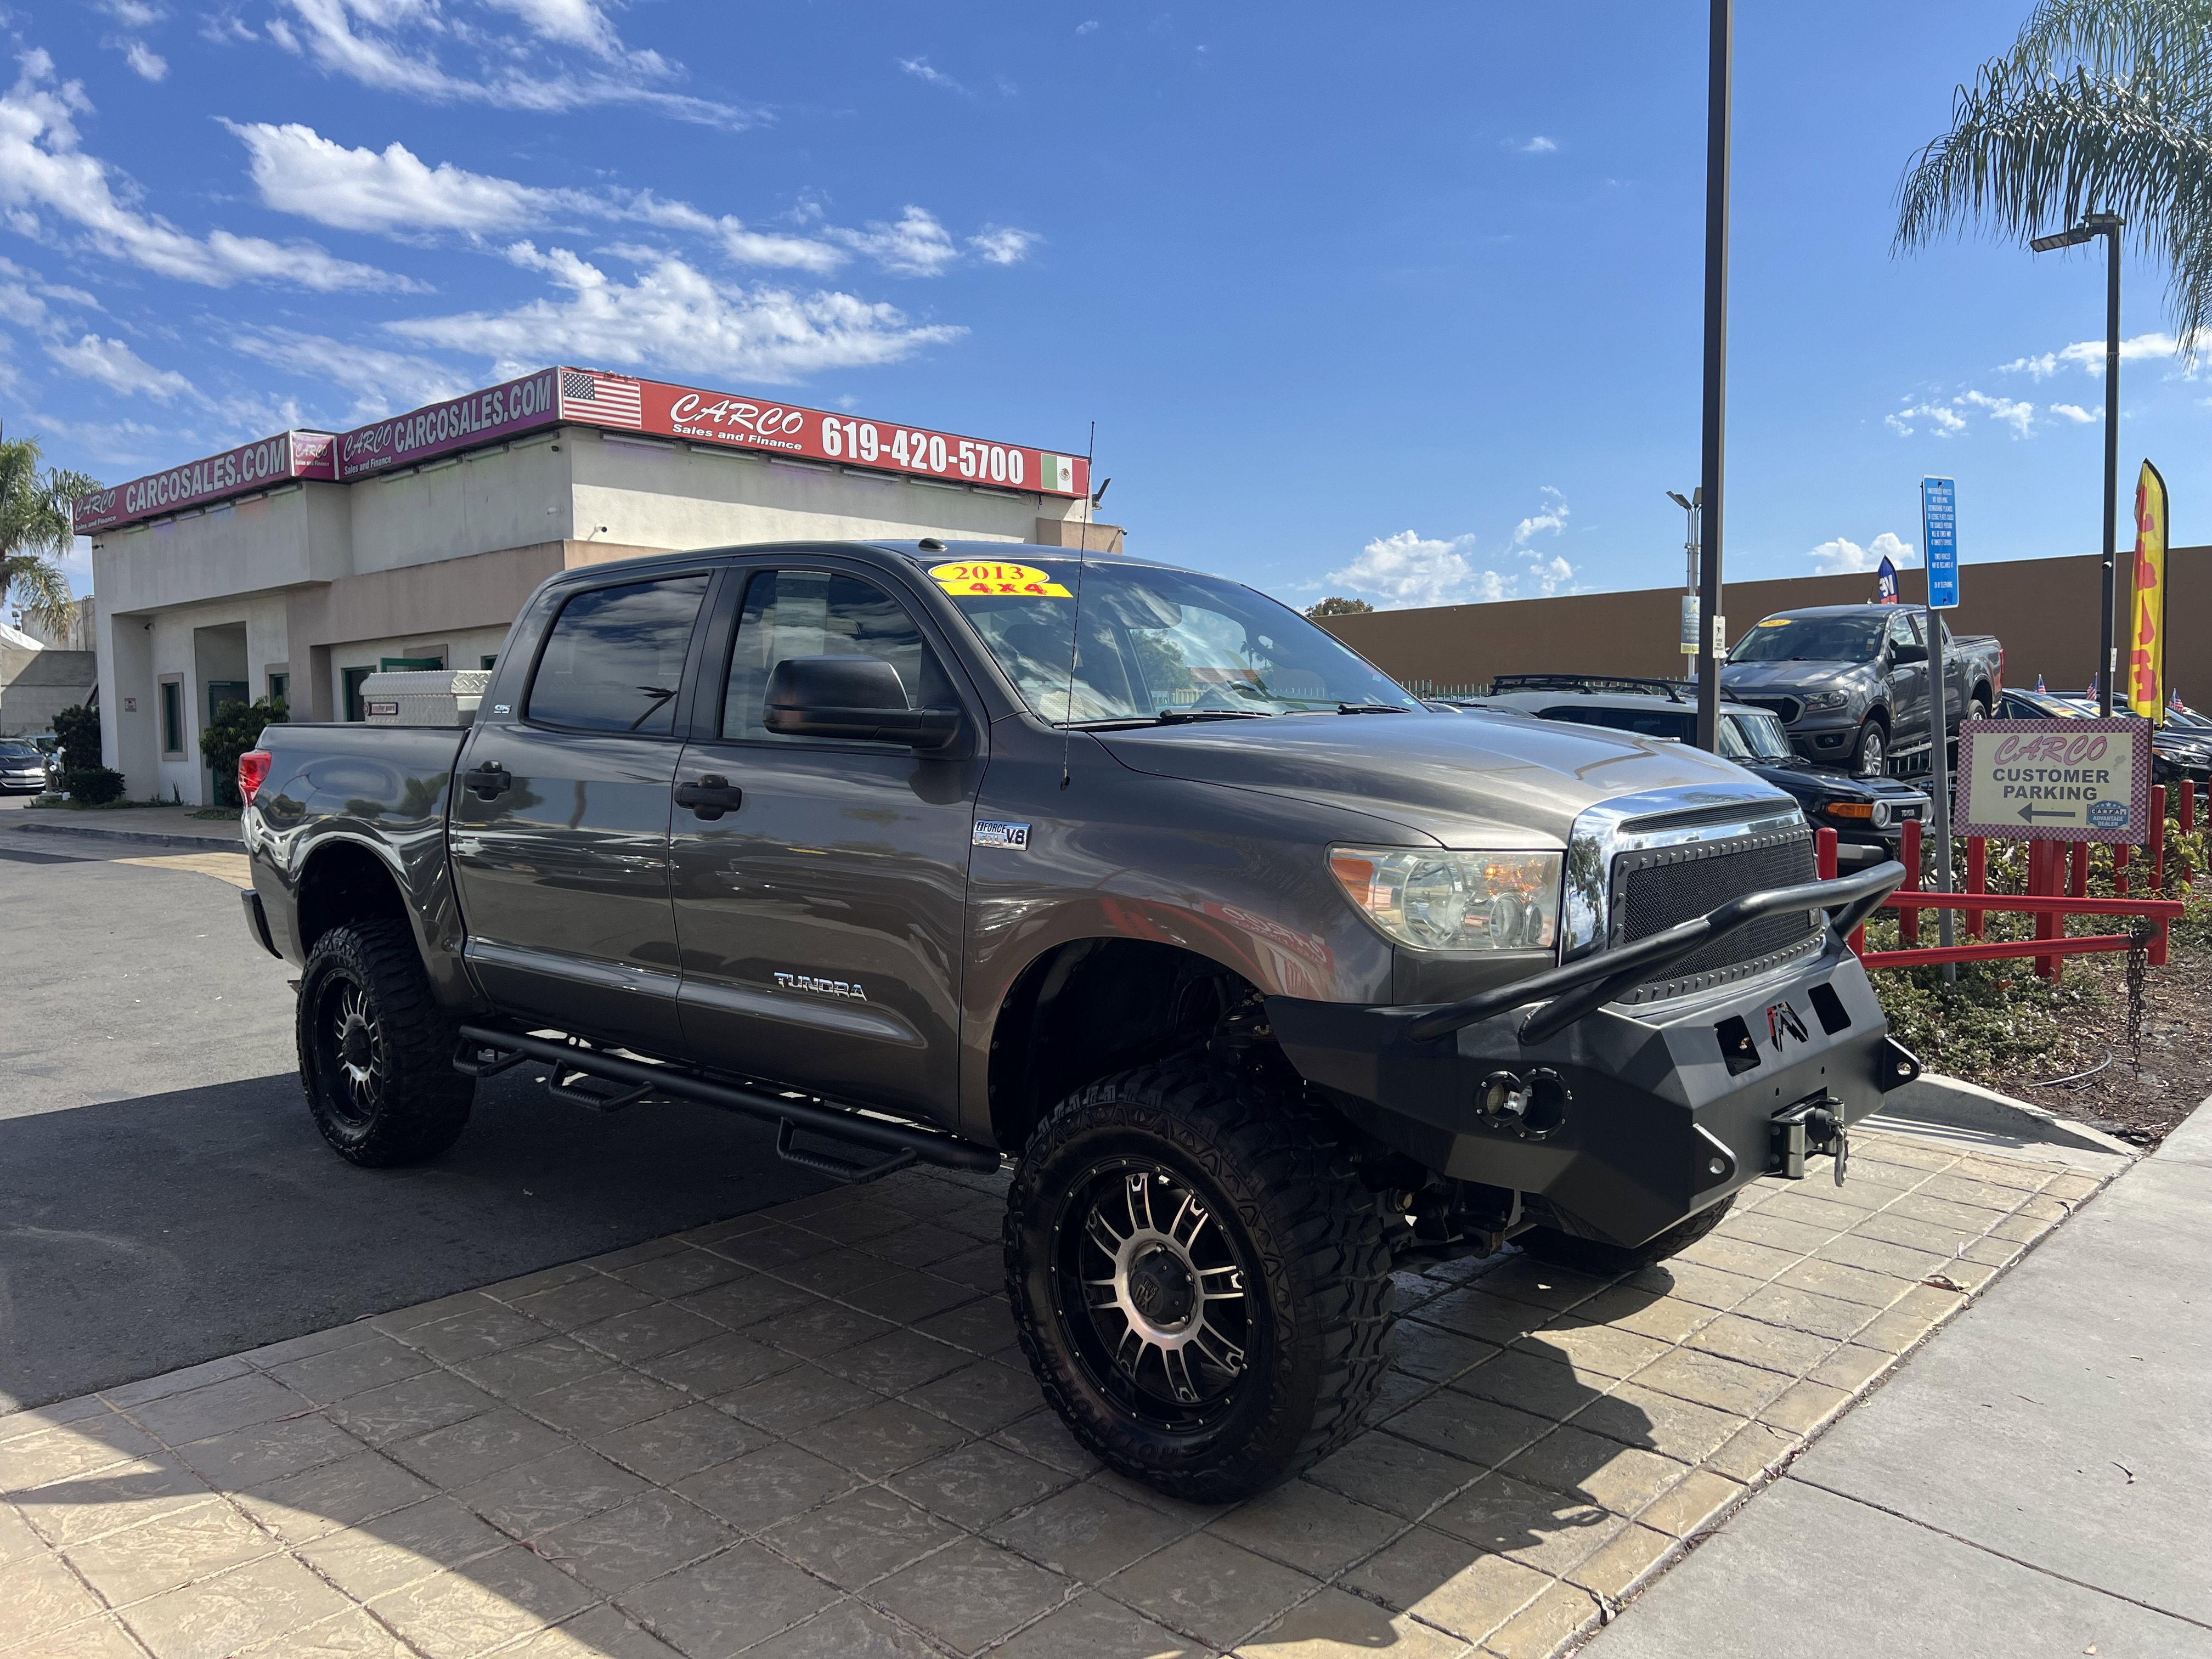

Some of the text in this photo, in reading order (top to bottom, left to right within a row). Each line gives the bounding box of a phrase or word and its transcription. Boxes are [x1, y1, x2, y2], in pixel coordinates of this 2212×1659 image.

[395, 375, 551, 453] CARCOSALES.COM
[670, 393, 803, 435] CARCO
[343, 424, 392, 462] CARCO
[673, 424, 803, 450] Sales and Finance
[822, 417, 1024, 484] 619-420-5700
[296, 444, 328, 458] CARCO
[126, 438, 285, 514] CARCOSALES.COM
[345, 456, 392, 476] Sales and Finance
[75, 489, 116, 521] CARCO
[98, 515, 116, 525] Finance
[952, 566, 1024, 580] 2013
[1994, 735, 2107, 765] CARCO
[1993, 769, 2109, 783] CUSTOMER
[2003, 785, 2097, 800] PARKING
[1006, 828, 1025, 844] V8
[774, 972, 868, 1001] TUNDRA
